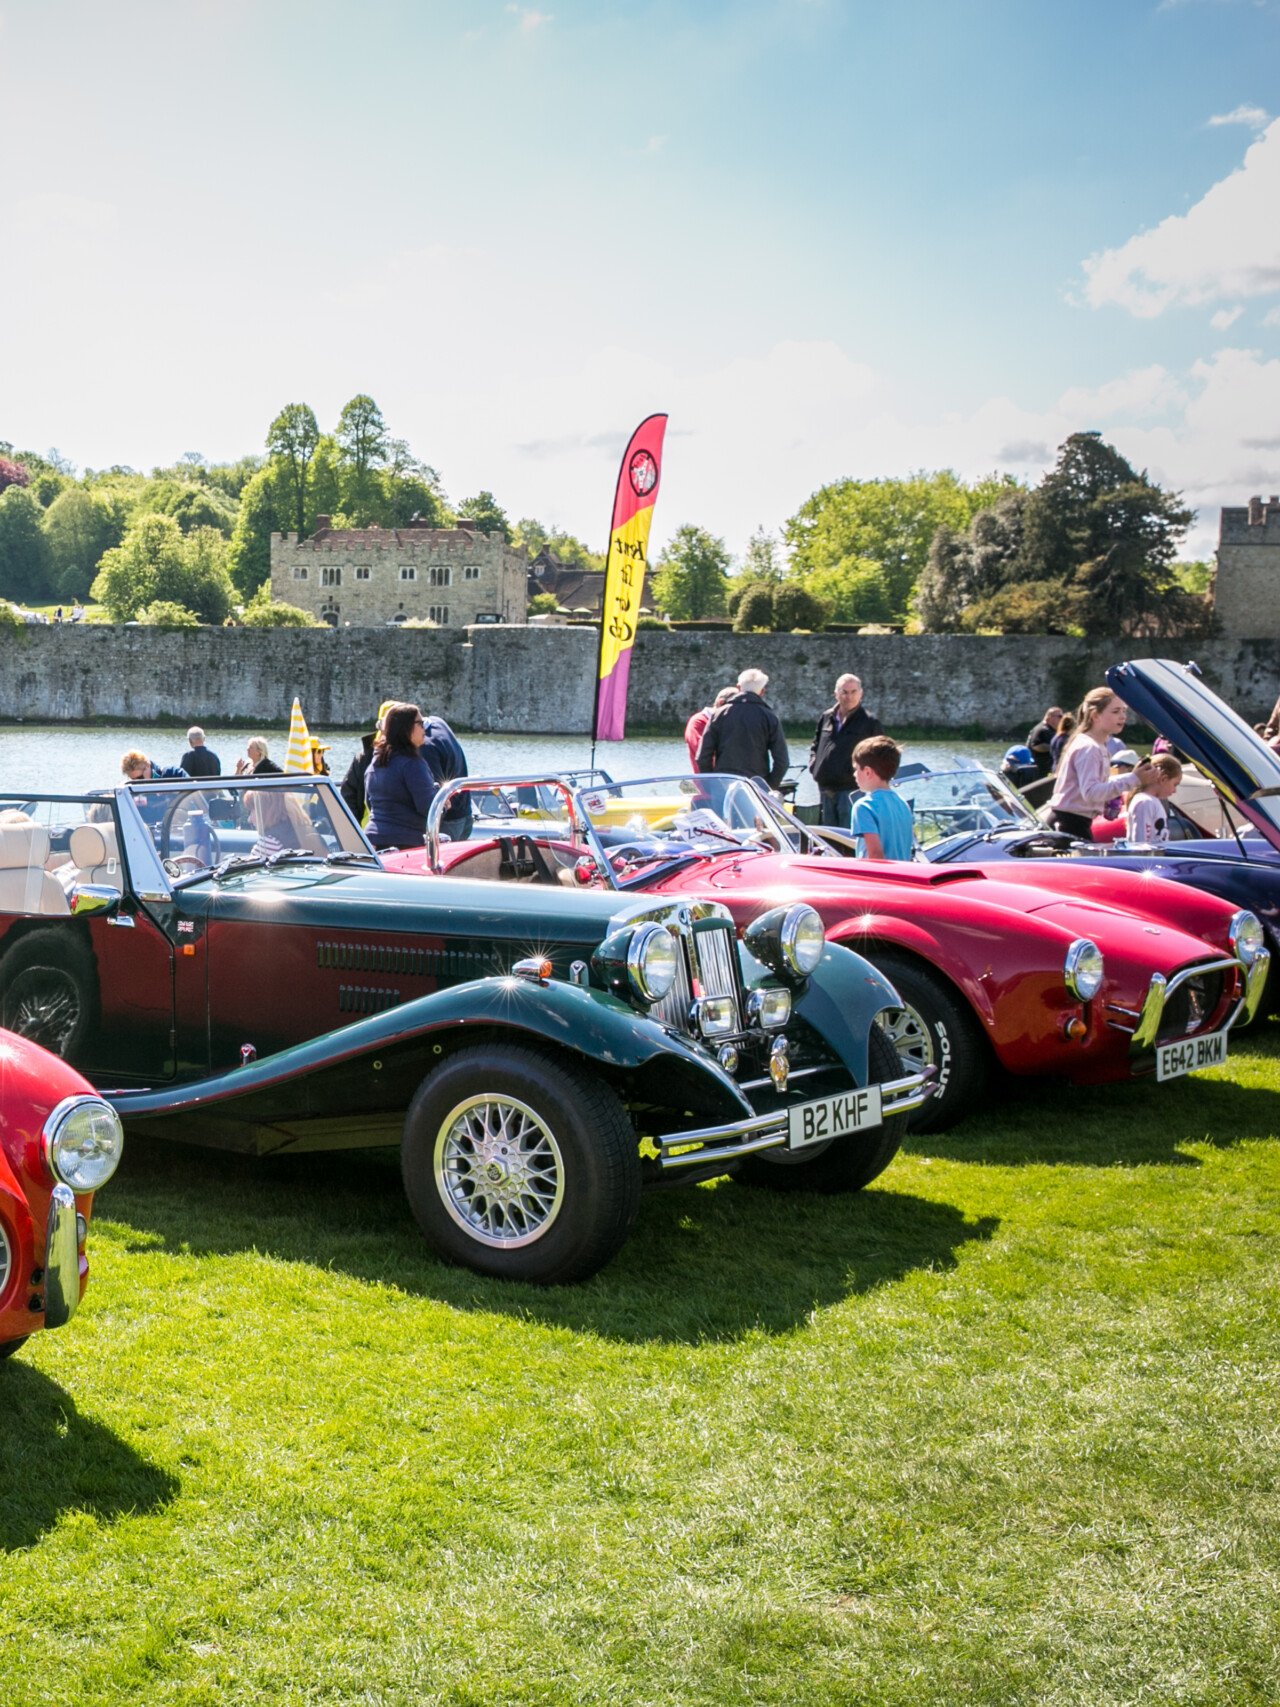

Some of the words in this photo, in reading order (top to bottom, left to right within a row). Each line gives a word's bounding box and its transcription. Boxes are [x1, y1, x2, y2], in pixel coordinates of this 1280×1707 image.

[933, 1020, 951, 1099] SOLUS
[1162, 1043, 1194, 1076] E642
[1196, 1036, 1222, 1065] BKM
[803, 1103, 828, 1140] B2
[832, 1092, 868, 1132] KHF
